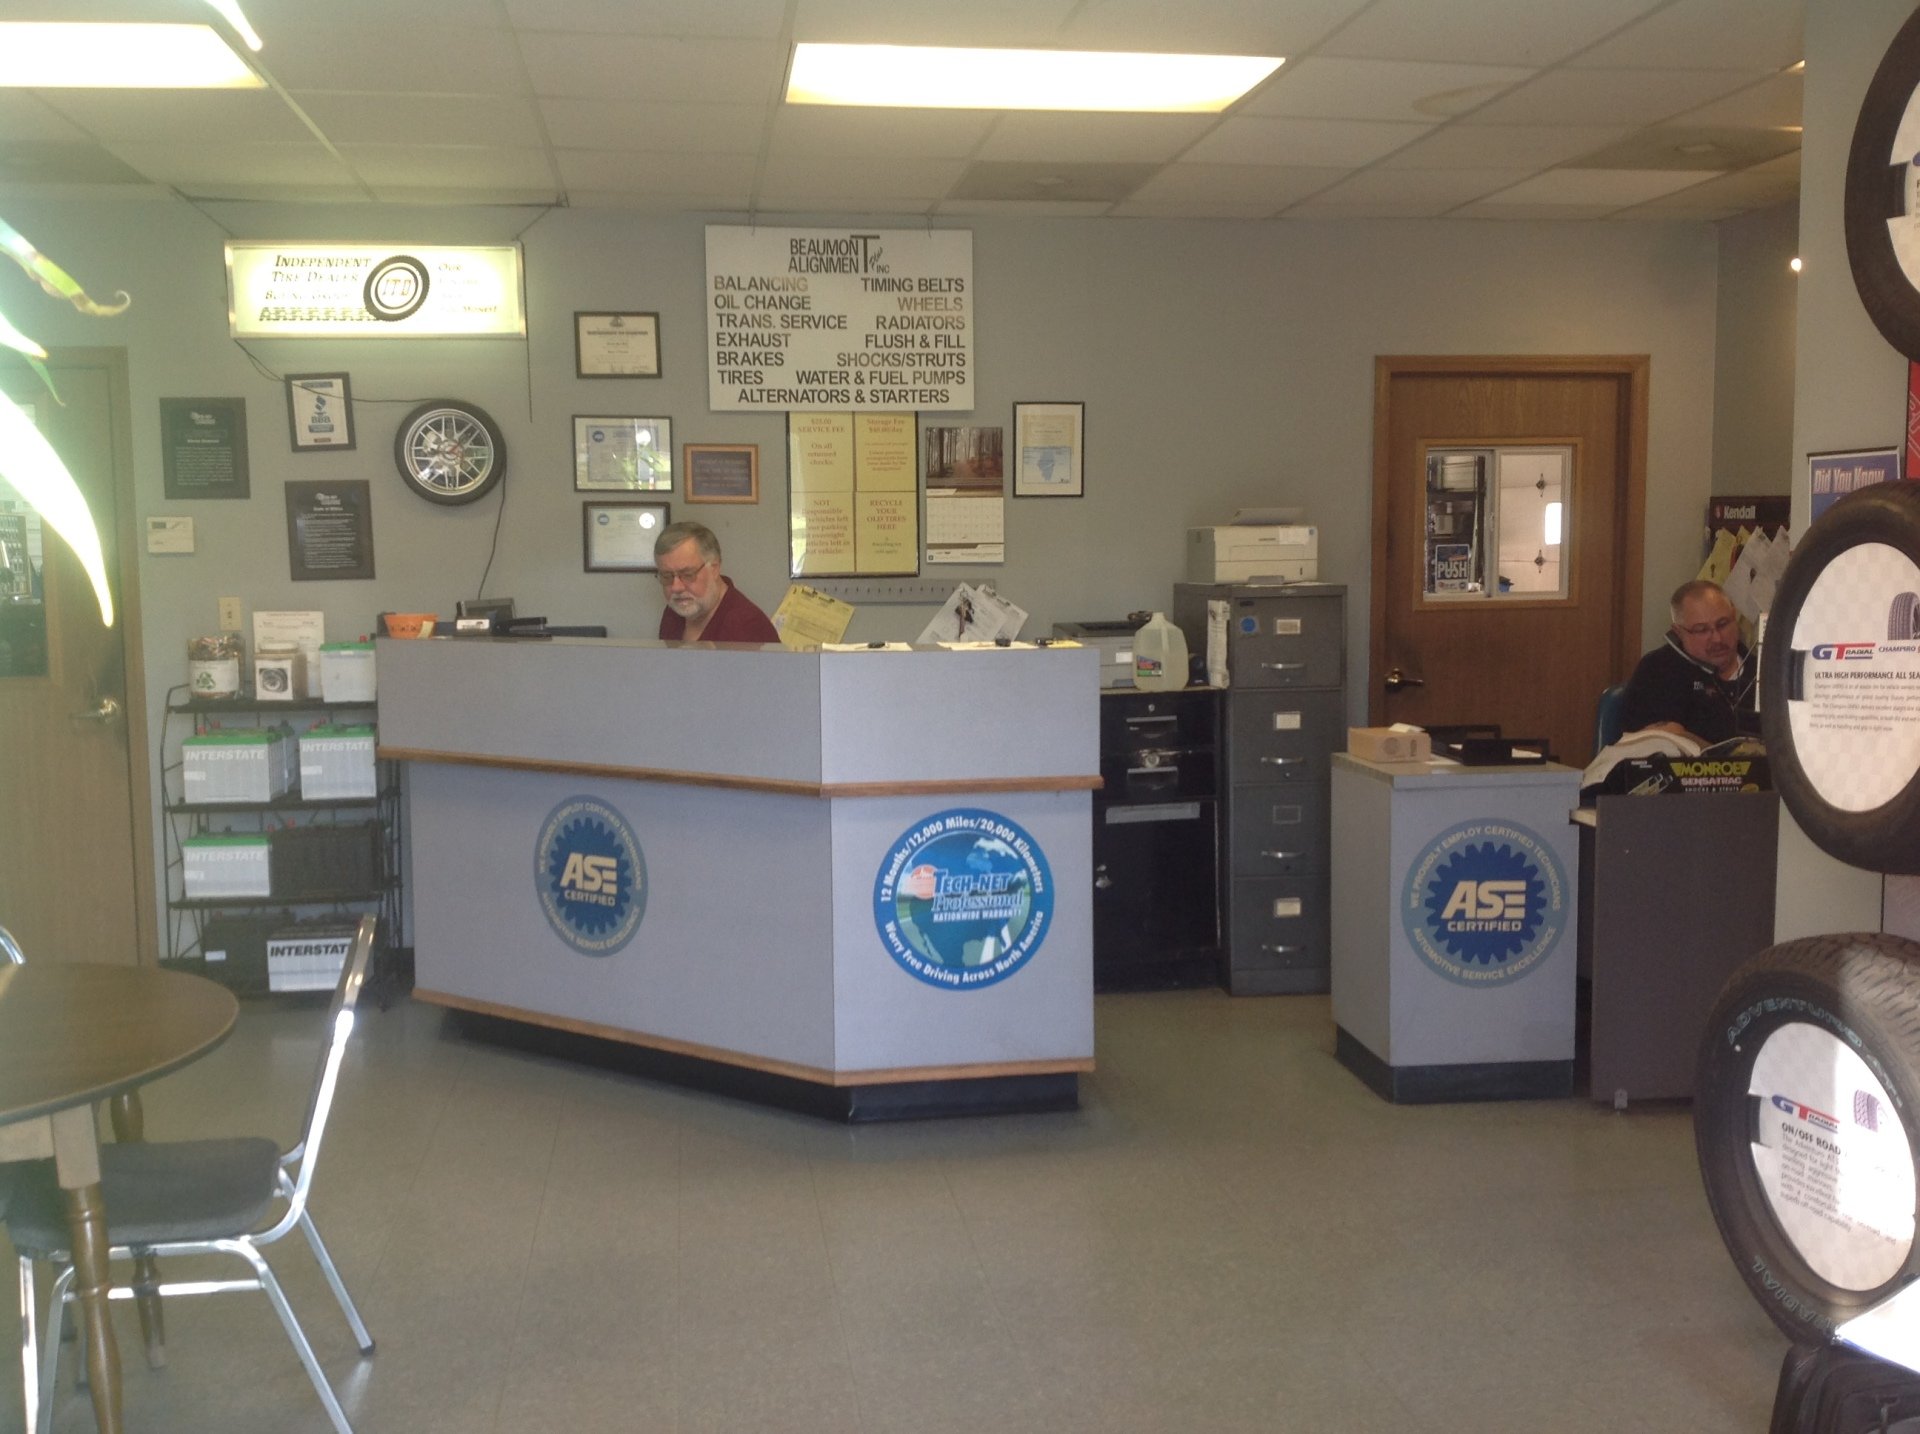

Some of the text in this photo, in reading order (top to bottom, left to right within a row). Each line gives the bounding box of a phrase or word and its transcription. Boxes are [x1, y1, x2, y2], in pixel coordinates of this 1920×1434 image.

[275, 254, 372, 267] INDEPENDENT
[876, 265, 890, 273] INC
[714, 276, 808, 292] BALANCING
[861, 278, 964, 292] TIMING BELTS
[714, 295, 811, 310] OIL CHANGE
[898, 297, 963, 312] WHEELS
[716, 313, 847, 329] TRANS. SERVICE
[876, 316, 965, 330] RADIATORS
[716, 332, 791, 348] EXHAUST
[865, 334, 965, 348] FLUSH & FILL
[717, 351, 784, 366] BRAKES
[837, 353, 965, 368] SHOCKS/STRUTS
[717, 370, 763, 385] TIRES
[796, 370, 965, 385] WATER & FUEL PUMPS
[738, 389, 949, 404] ALTERNATORS & STARTERS
[1814, 469, 1830, 493] Did
[1833, 468, 1851, 491] You
[1724, 505, 1756, 519] Kendall
[1438, 561, 1468, 578] PUSH
[302, 741, 372, 753] INTERSTATE
[186, 749, 265, 761] INTERSTATE
[1680, 762, 1742, 776] MONROE
[1681, 777, 1742, 786] SENSATRAC
[946, 816, 1016, 841] Miles/20,000
[1442, 827, 1481, 848] EMPLOY
[1484, 825, 1534, 848] CERTIFIED
[186, 850, 265, 862] INTERSTATE
[883, 821, 943, 885] Months/12,000
[1013, 838, 1043, 893] Kilometers
[560, 852, 618, 895] ASE
[564, 890, 615, 907] CERTIFIED
[881, 888, 891, 902] 12
[1440, 880, 1527, 919] ASE
[933, 909, 1021, 922] NATIONWIDE WARRANTY
[1447, 921, 1522, 932] CERTIFIED
[270, 943, 349, 956] INTERSTAT
[885, 911, 1043, 985] Worry Free Driving Across North America
[1413, 928, 1556, 980] AUTOMOTIVE SERVICE EXCELLENCE
[1782, 1122, 1841, 1155] ON/OFF ROAD
